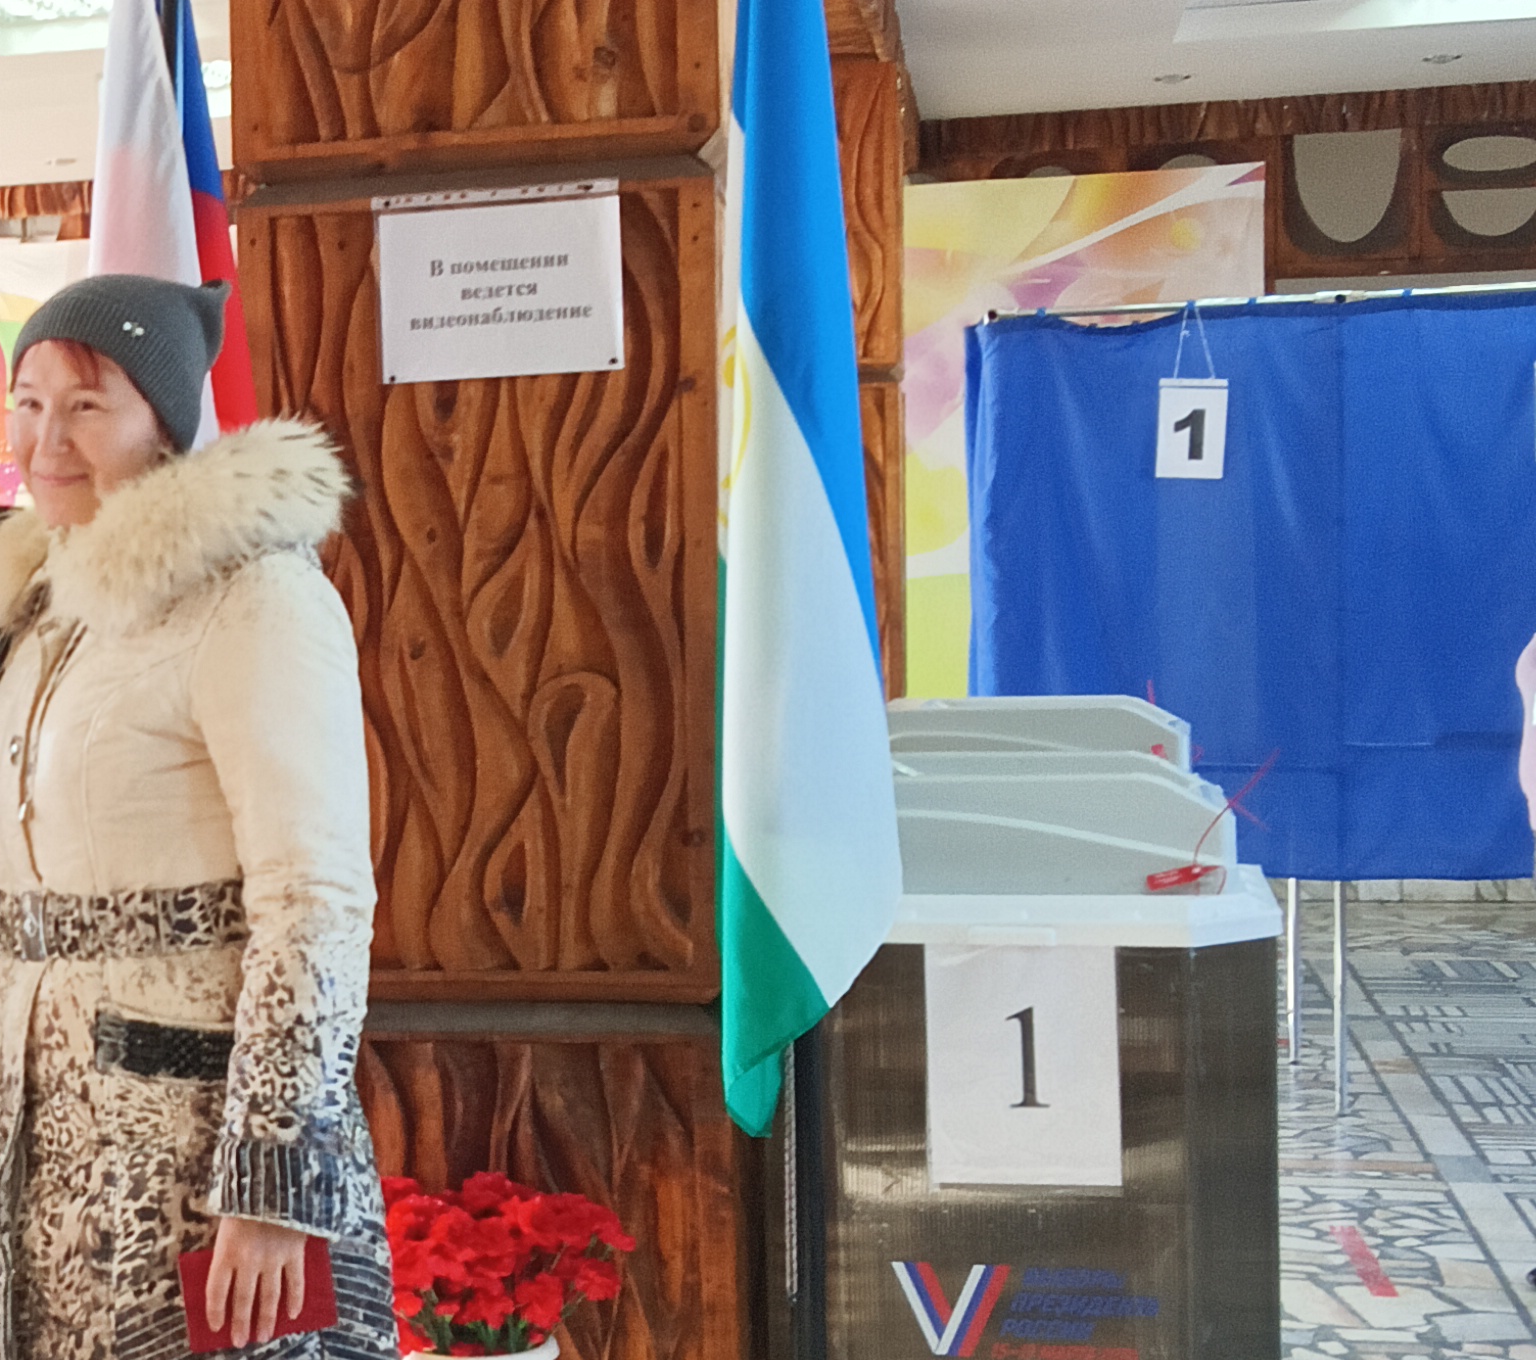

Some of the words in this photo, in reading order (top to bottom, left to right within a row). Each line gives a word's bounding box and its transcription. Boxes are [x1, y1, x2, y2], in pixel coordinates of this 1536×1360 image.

[429, 259, 444, 277] В
[450, 254, 569, 275] помещении
[460, 282, 538, 301] ведется
[409, 304, 593, 331] видеонаблюдение
[1173, 408, 1206, 460] 1
[1005, 1006, 1051, 1108] 1
